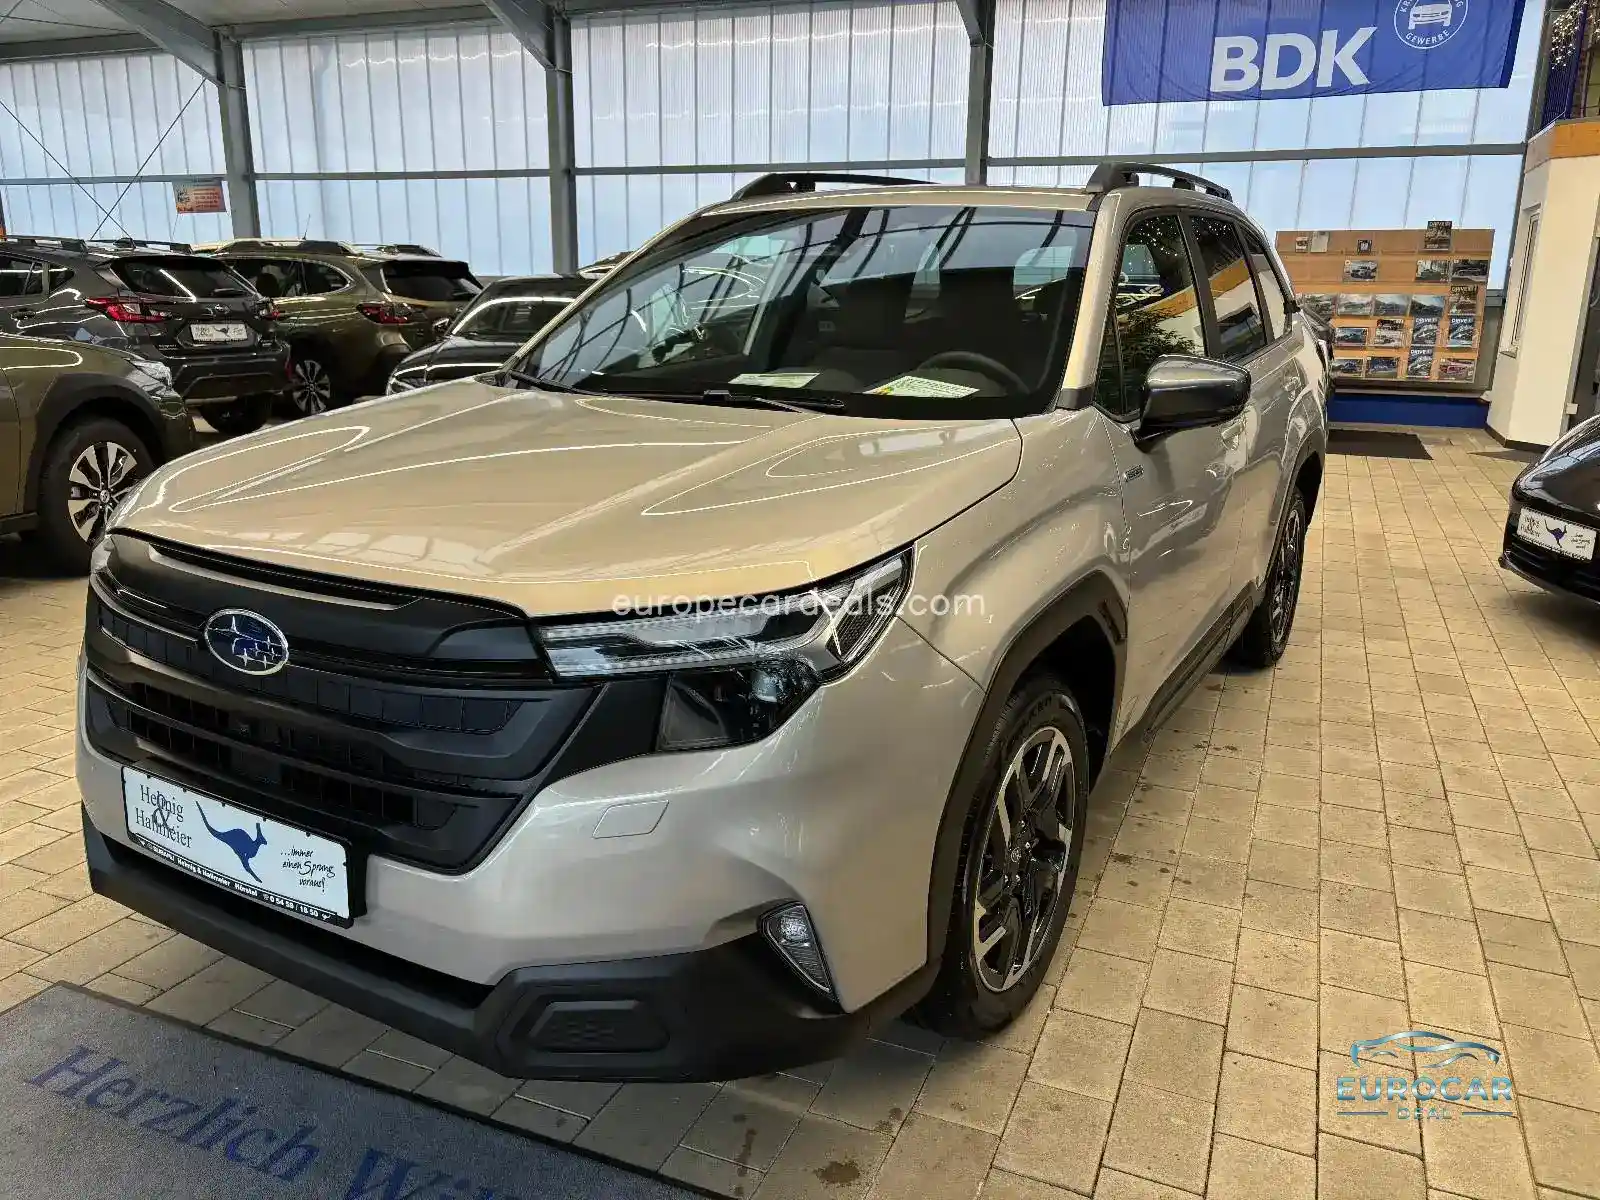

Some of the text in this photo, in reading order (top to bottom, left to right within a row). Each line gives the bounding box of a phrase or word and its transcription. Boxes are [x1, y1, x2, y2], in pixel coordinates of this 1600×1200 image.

[1405, 29, 1450, 45] GEWERBE
[1209, 26, 1378, 93] BDK
[283, 859, 335, 878] einen Sprung
[299, 877, 325, 892] voraus!
[25, 1044, 318, 1183] Herzlich
